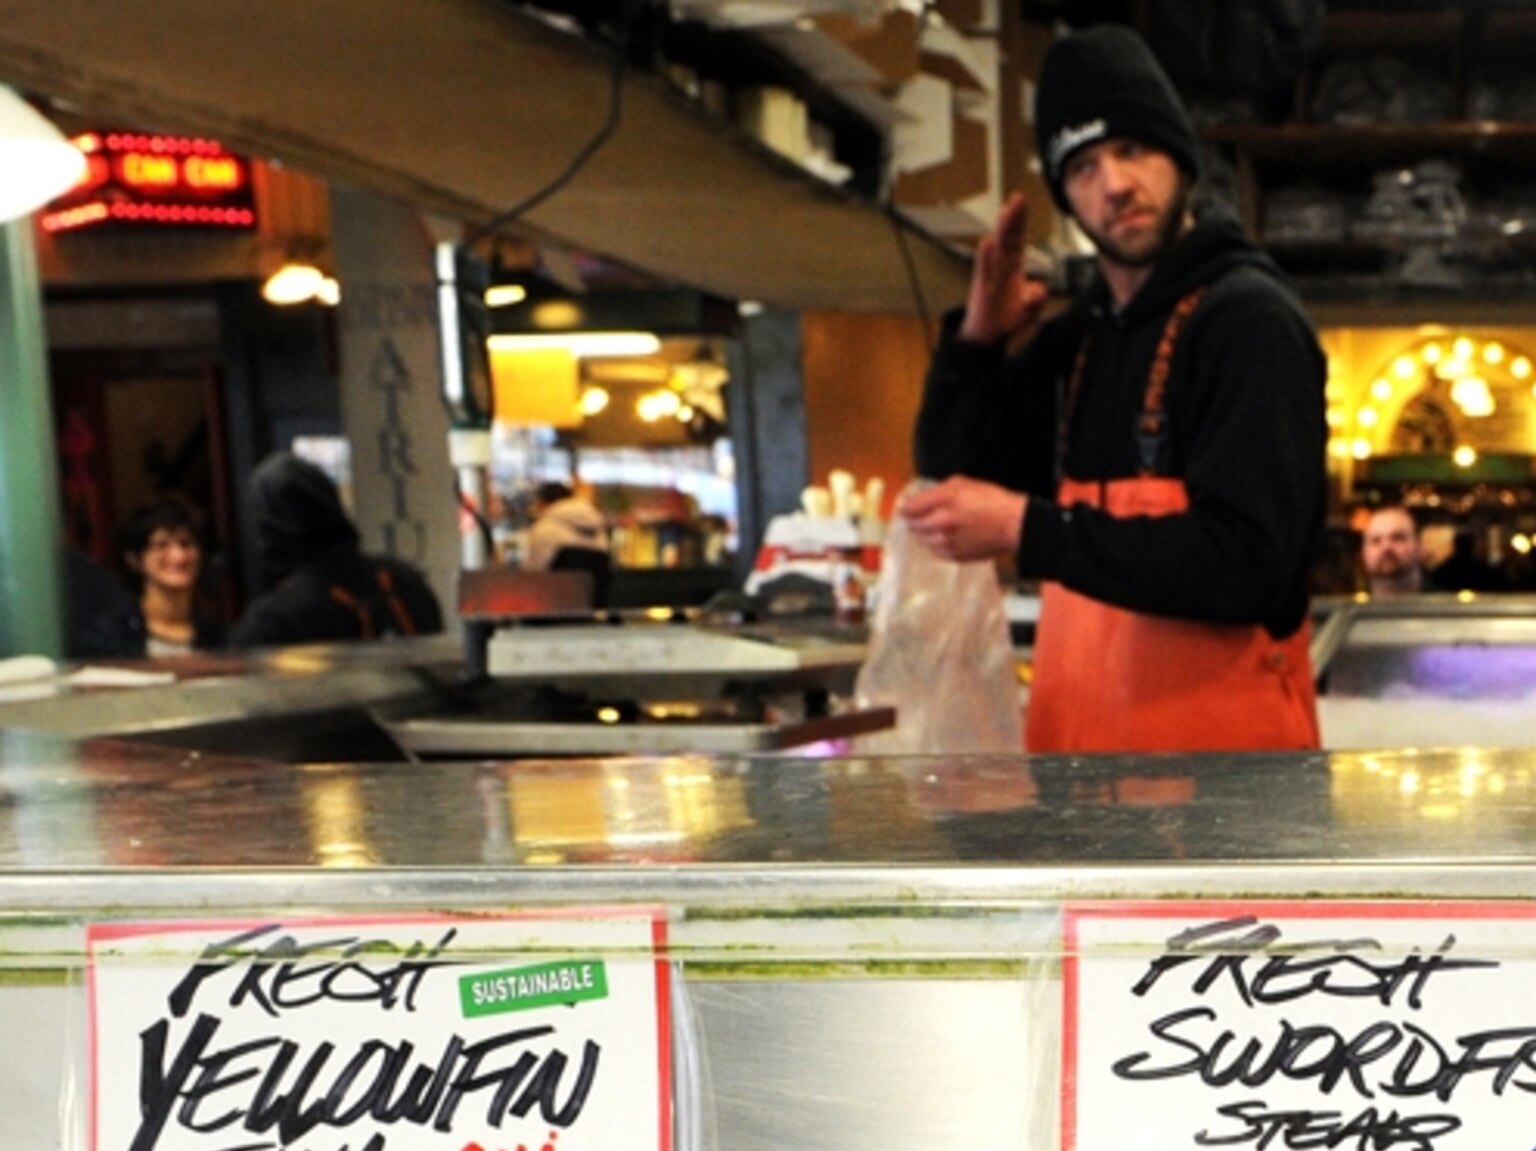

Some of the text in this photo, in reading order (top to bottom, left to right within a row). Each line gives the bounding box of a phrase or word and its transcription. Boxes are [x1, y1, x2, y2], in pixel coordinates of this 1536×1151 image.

[168, 925, 468, 1018] FRESH
[471, 964, 595, 1005] SUSTAINABLE
[1131, 917, 1500, 1011] FRESH
